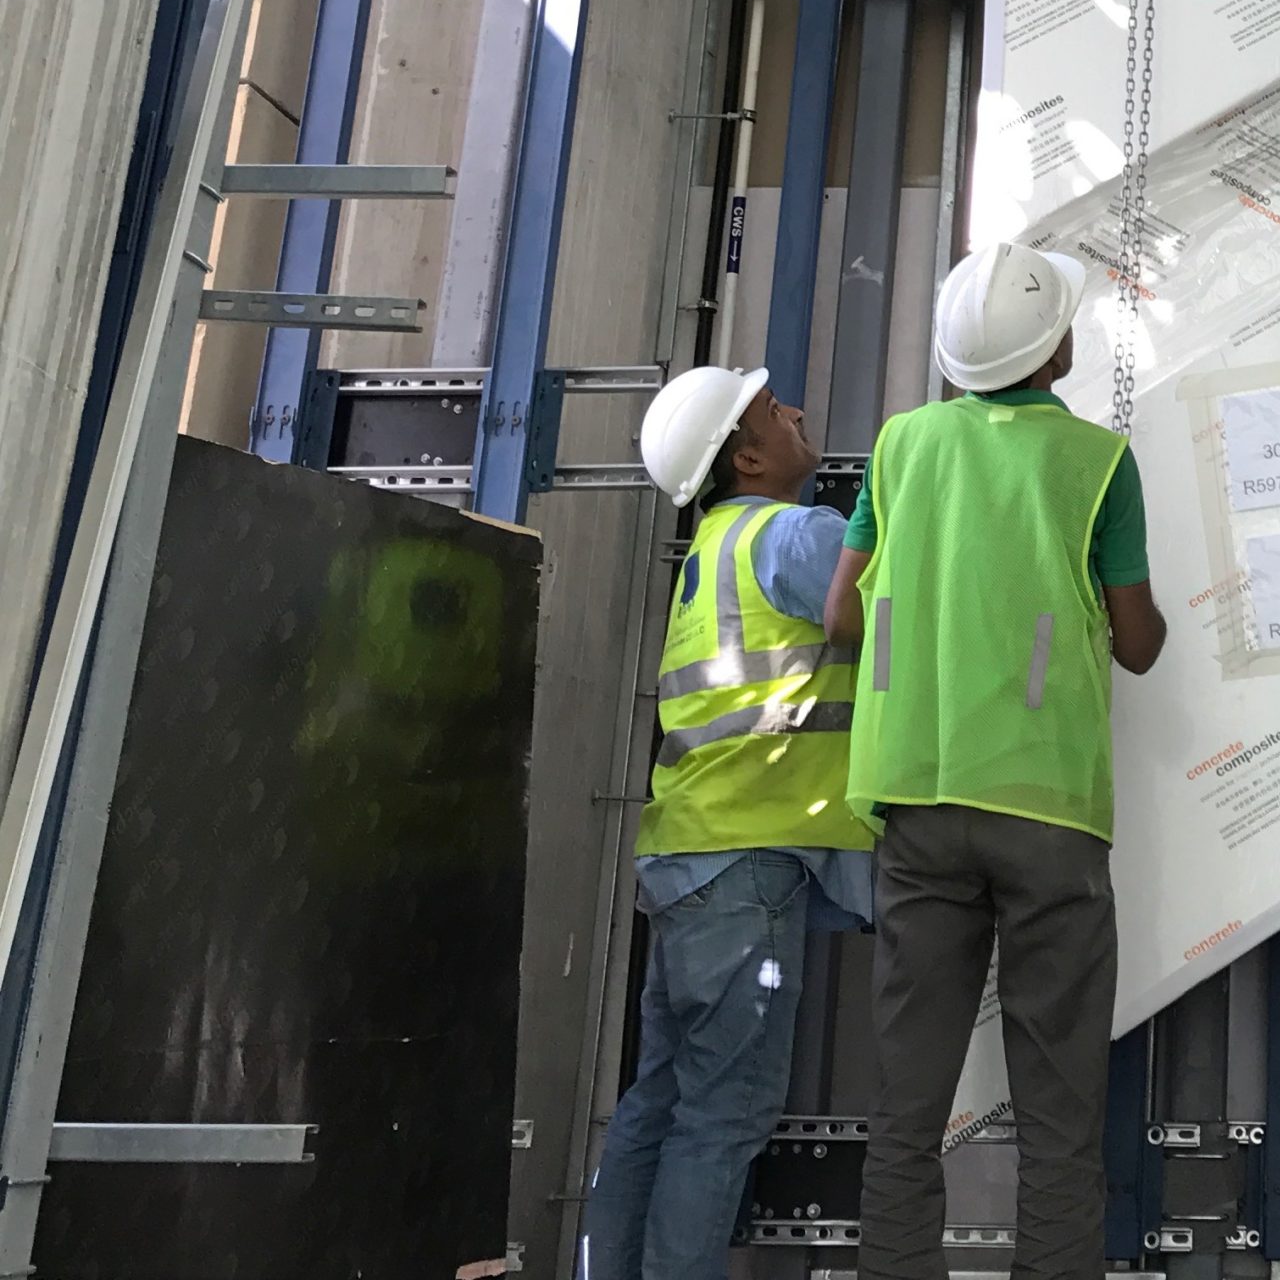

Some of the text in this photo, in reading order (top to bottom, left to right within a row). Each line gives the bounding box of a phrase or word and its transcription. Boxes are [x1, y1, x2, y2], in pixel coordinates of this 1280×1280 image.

[732, 207, 744, 236] CWS
[1186, 741, 1244, 780] concrete
[1184, 919, 1244, 961] concrete
